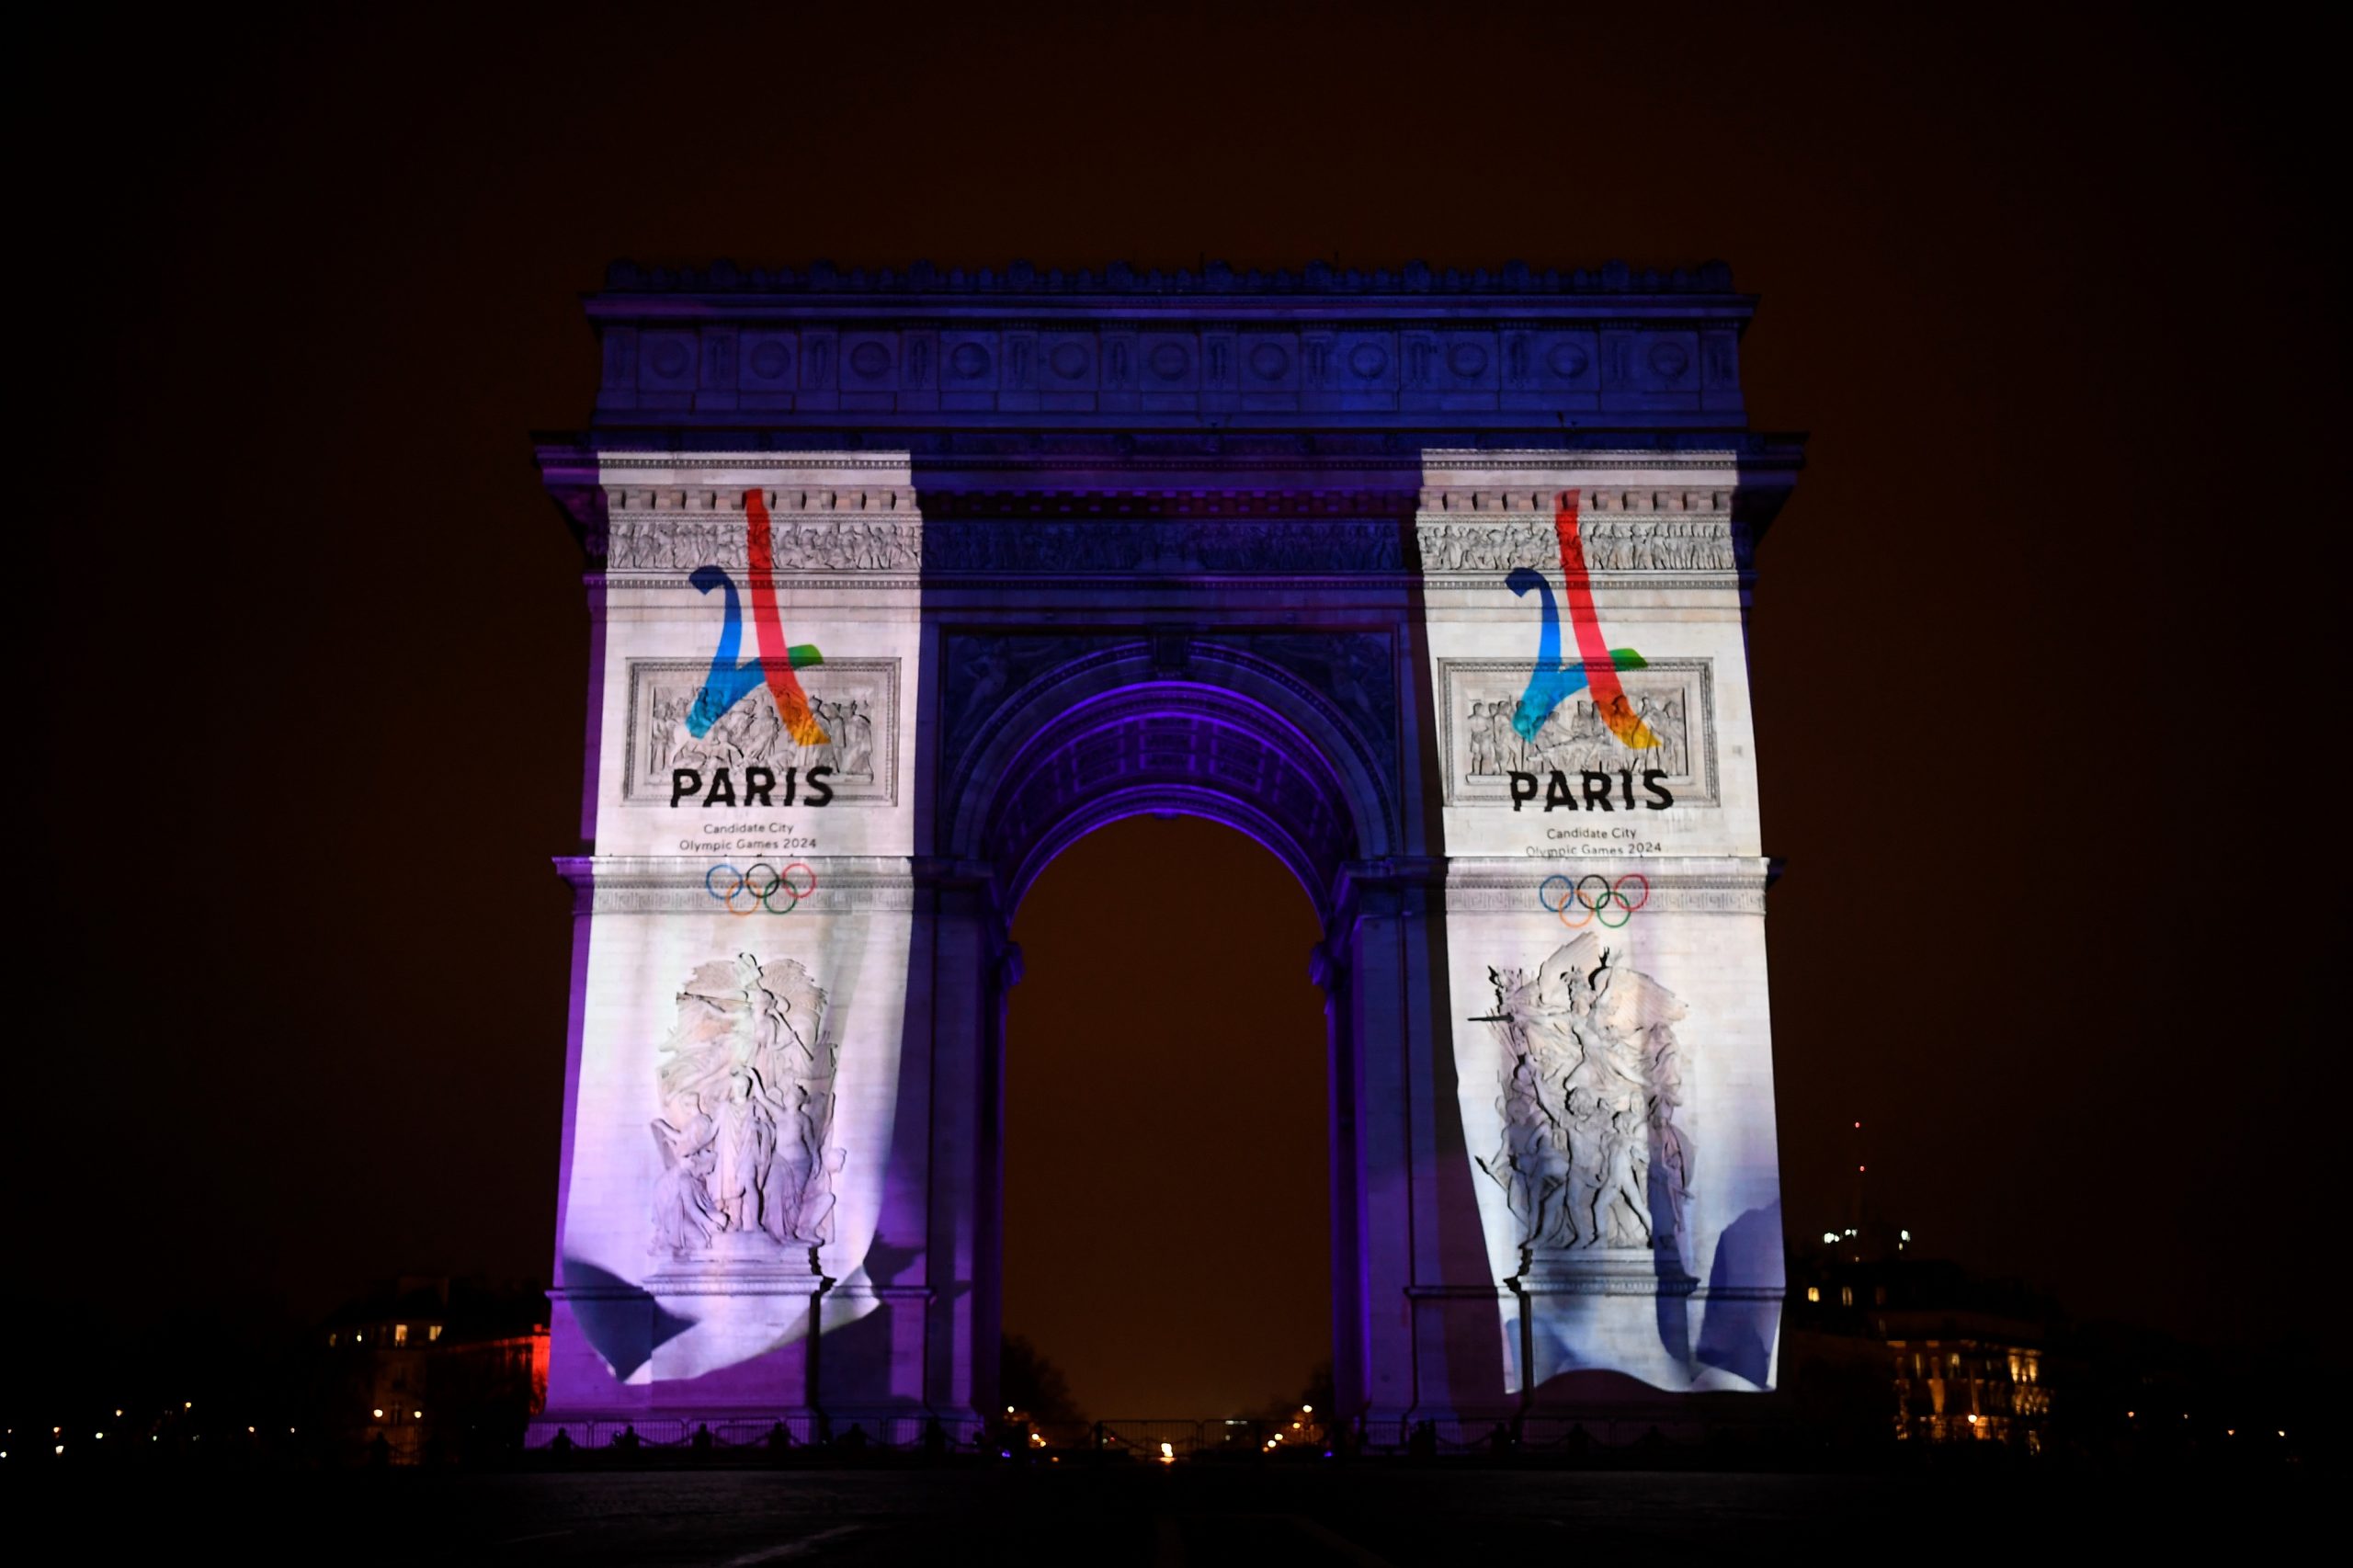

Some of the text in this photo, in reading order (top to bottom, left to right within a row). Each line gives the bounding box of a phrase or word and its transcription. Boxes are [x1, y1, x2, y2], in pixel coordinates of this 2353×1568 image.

[670, 766, 834, 808] PARIS
[1506, 768, 1674, 812] PARIS
[703, 822, 794, 835] Candidate City
[1546, 827, 1637, 839] Candidate City
[679, 837, 817, 852] Olympic Games 2024
[1581, 844, 1623, 855] Games
[1628, 842, 1662, 854] 2024
